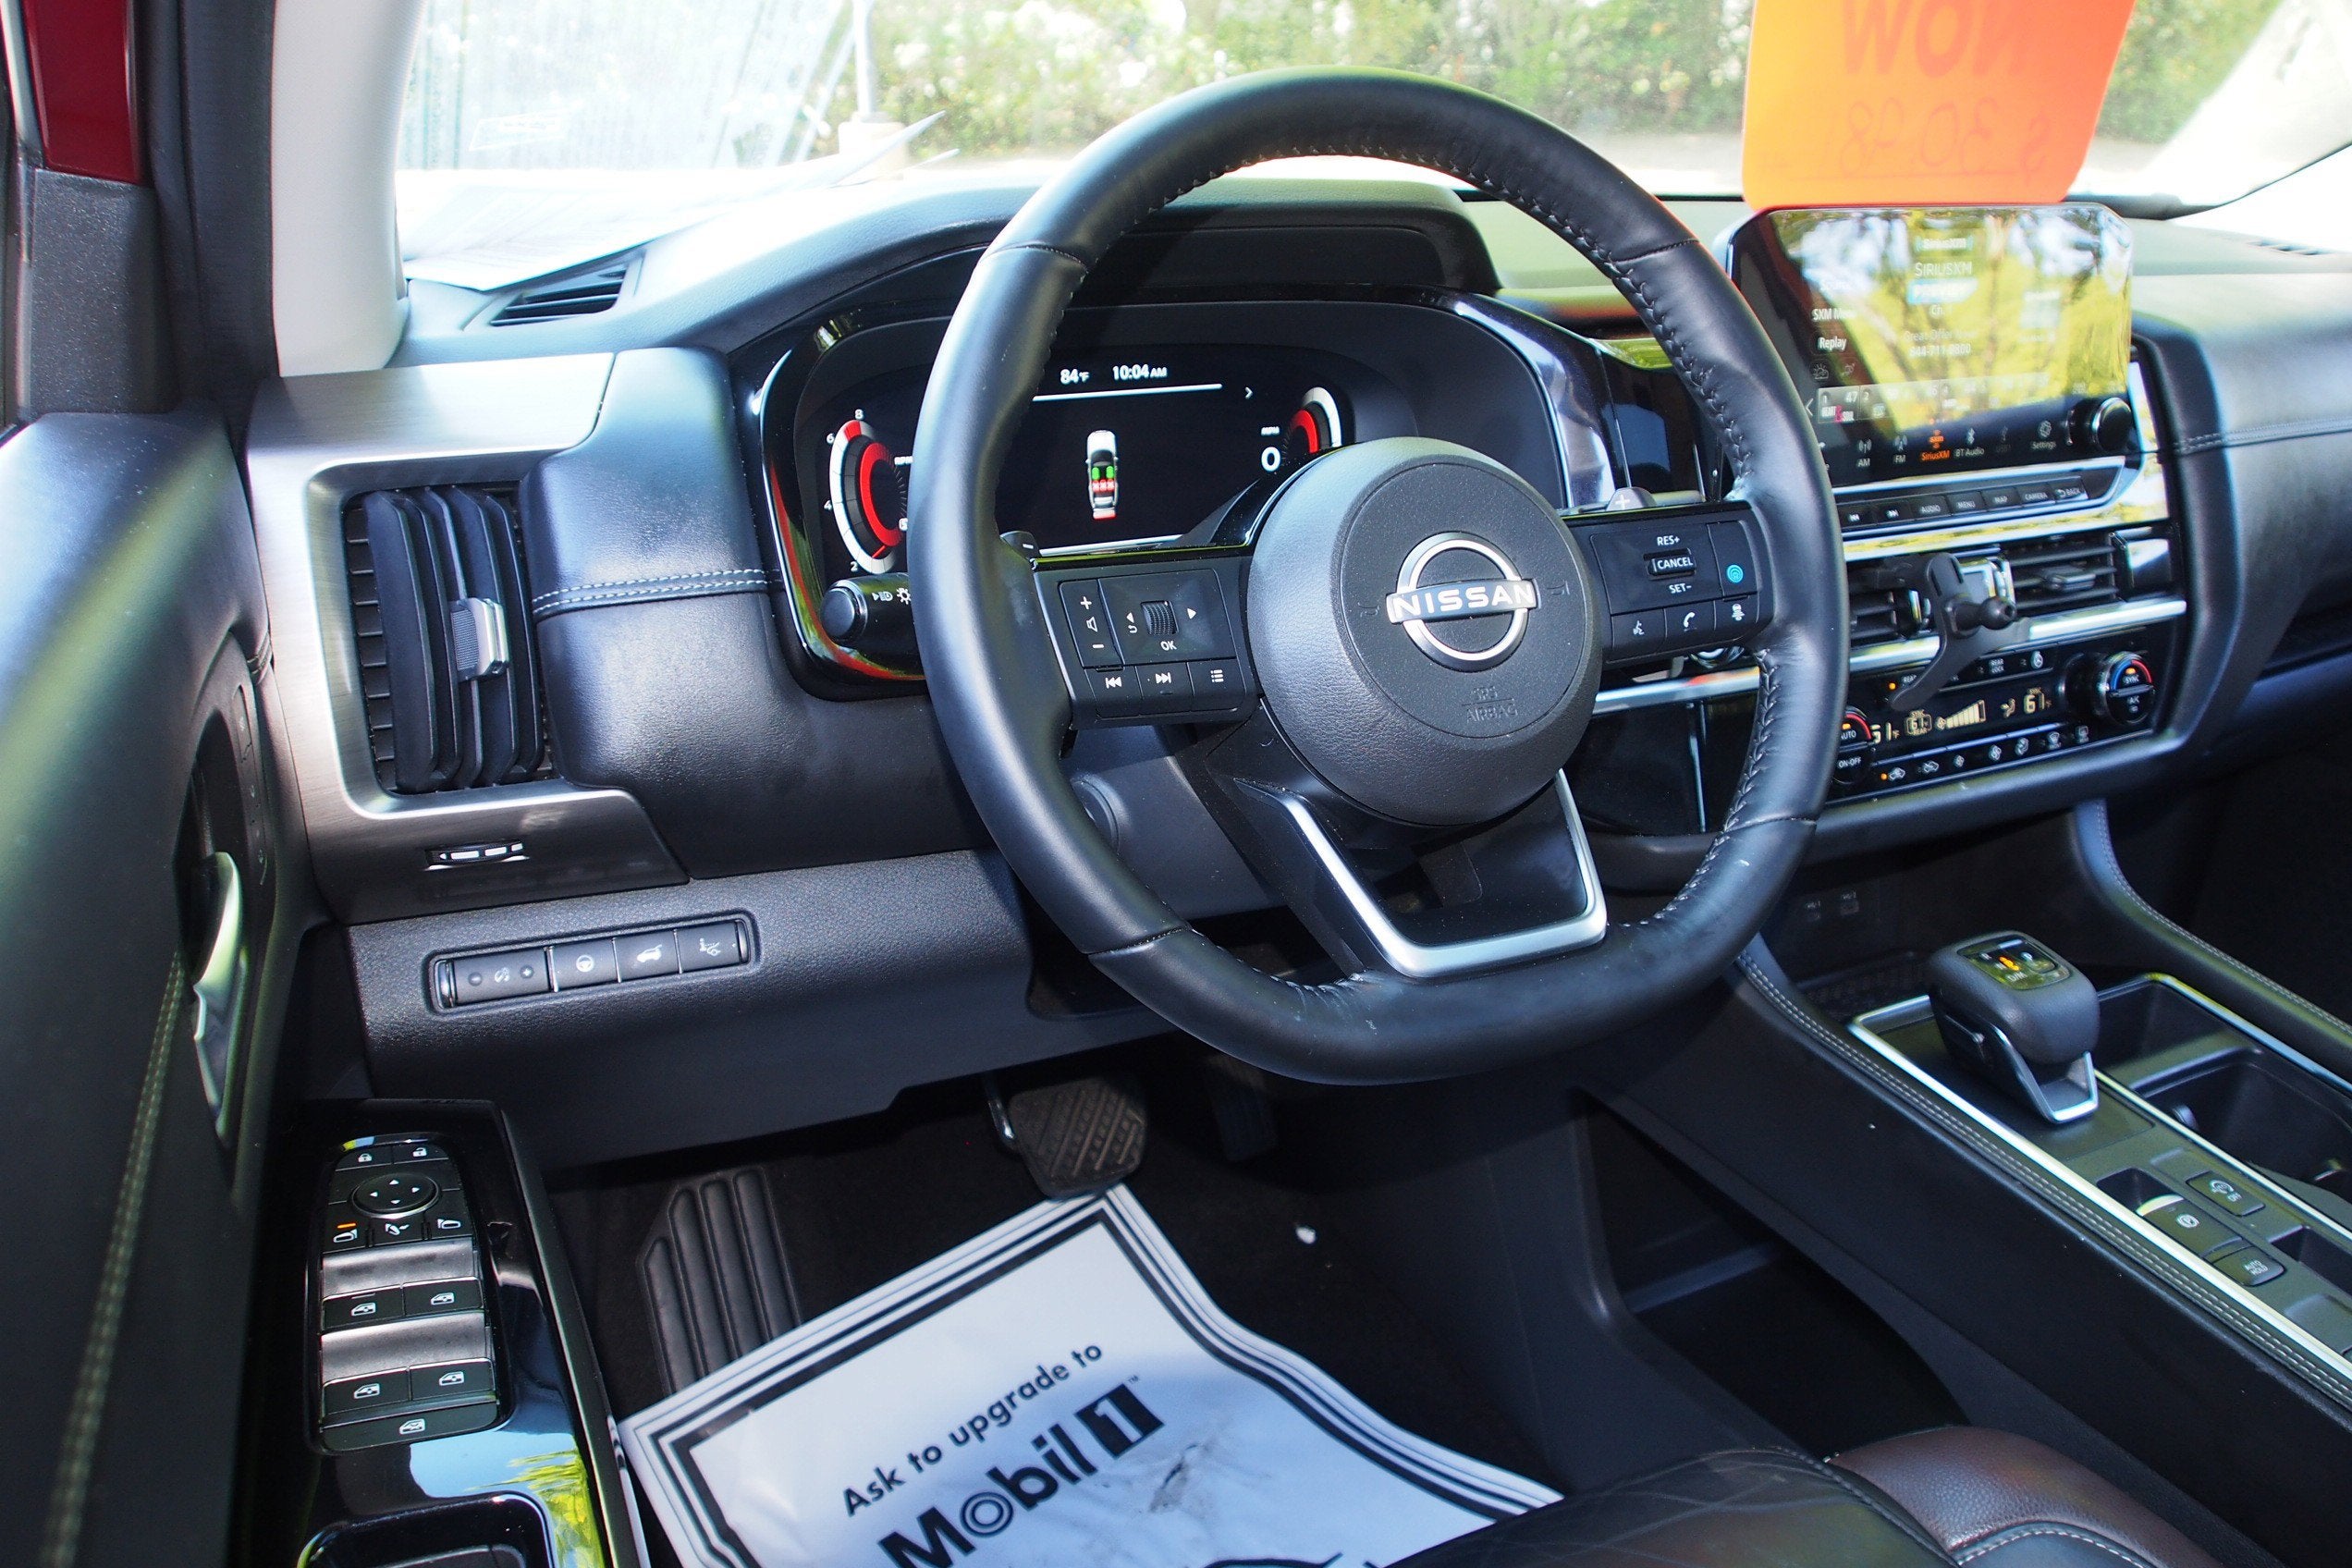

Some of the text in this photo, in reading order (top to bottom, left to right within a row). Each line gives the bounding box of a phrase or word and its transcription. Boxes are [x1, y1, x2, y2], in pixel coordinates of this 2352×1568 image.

[1818, 336, 1847, 351] Replay
[854, 409, 864, 420] 8
[826, 433, 836, 444] 6
[2032, 441, 2057, 450] Settings
[1921, 449, 1951, 461] SiriusXM
[1955, 446, 1985, 458] BT Audio
[1261, 446, 1281, 472] 0
[1857, 458, 1871, 468] AM
[1895, 454, 1906, 464] FM
[2024, 492, 2049, 501] CAMERA
[824, 499, 833, 511] 4
[1920, 504, 1942, 514] AUDIO
[1956, 500, 1976, 509] MENU
[1656, 535, 1681, 546] RES+
[850, 561, 859, 572] 2
[1657, 557, 1694, 570] CANCEL
[1668, 582, 1693, 594] SET-
[1392, 582, 1537, 619] NISSAN
[1160, 640, 1178, 652] OK
[2244, 1259, 2263, 1271] AUTO
[2249, 1264, 2269, 1277] HOLD
[843, 1344, 1103, 1518] Ask to upgrade to
[876, 1423, 1099, 1568] Mobil
